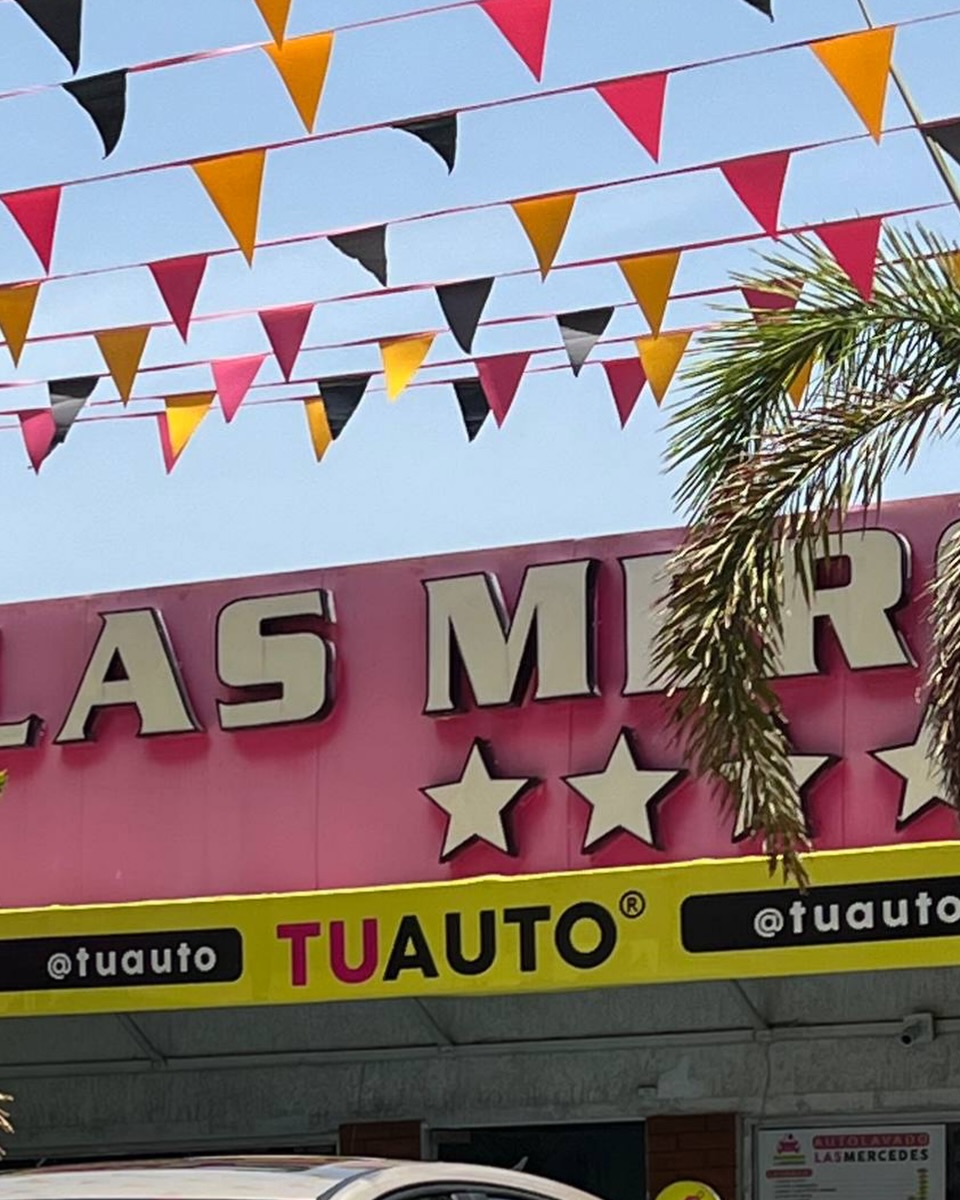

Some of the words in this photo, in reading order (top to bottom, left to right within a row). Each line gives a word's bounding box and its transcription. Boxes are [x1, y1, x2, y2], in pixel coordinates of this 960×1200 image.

[753, 891, 960, 938] @tuauto
[47, 942, 217, 979] @tuauto
[814, 1134, 929, 1148] AUTOLAVADO
